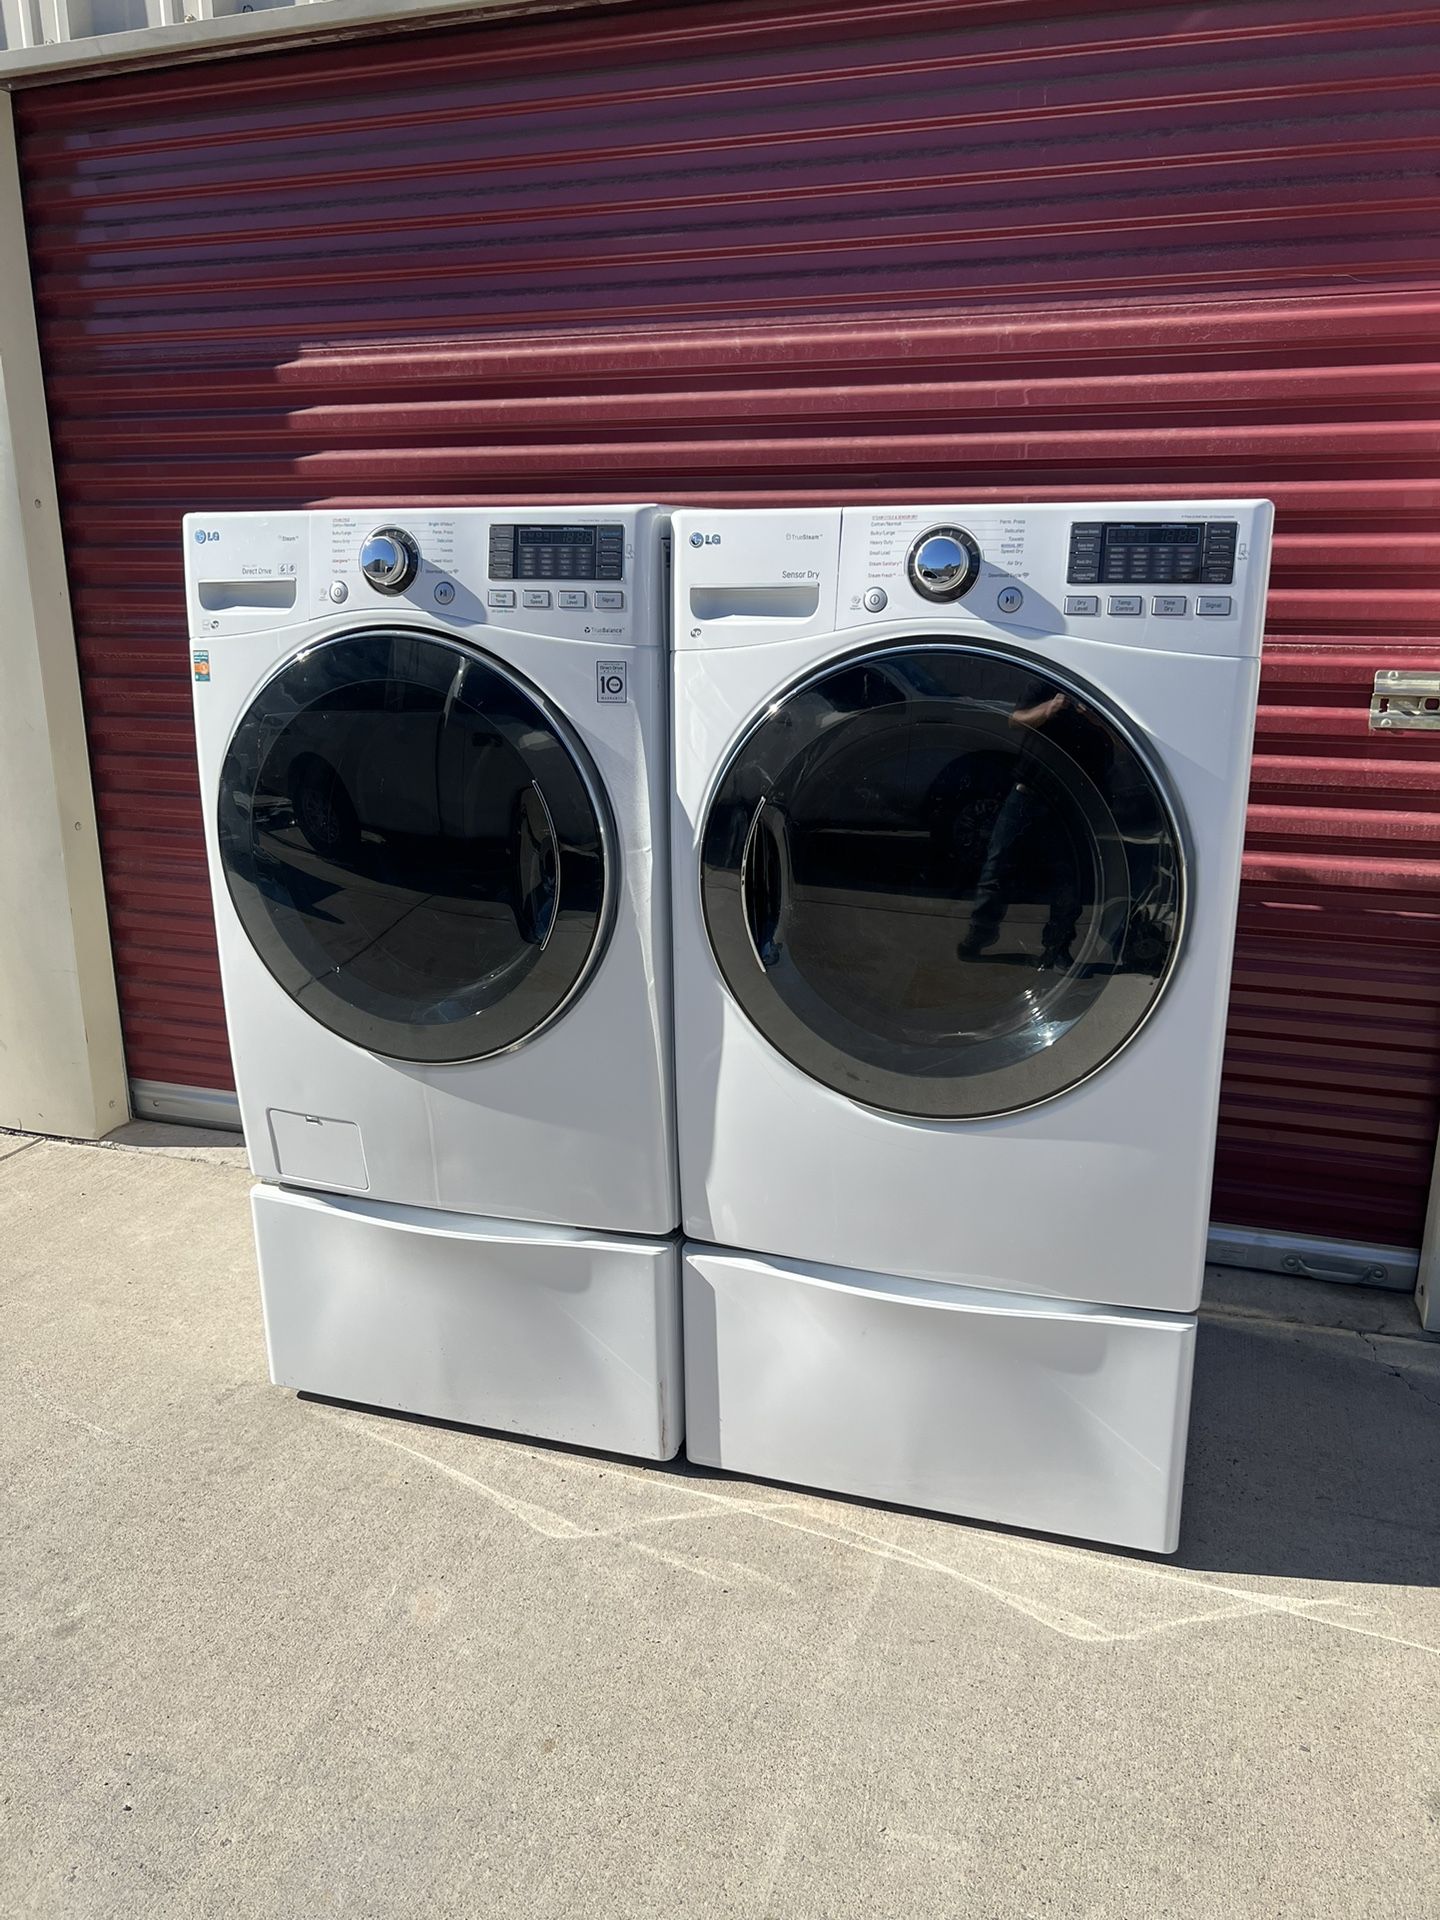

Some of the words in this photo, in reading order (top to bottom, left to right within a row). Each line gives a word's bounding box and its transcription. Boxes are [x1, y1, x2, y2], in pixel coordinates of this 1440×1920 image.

[207, 531, 220, 541] LG
[705, 534, 721, 545] LG
[258, 567, 272, 575] Drive
[782, 570, 806, 579] Sensor
[807, 570, 820, 580] Dry
[600, 676, 624, 694] 10
